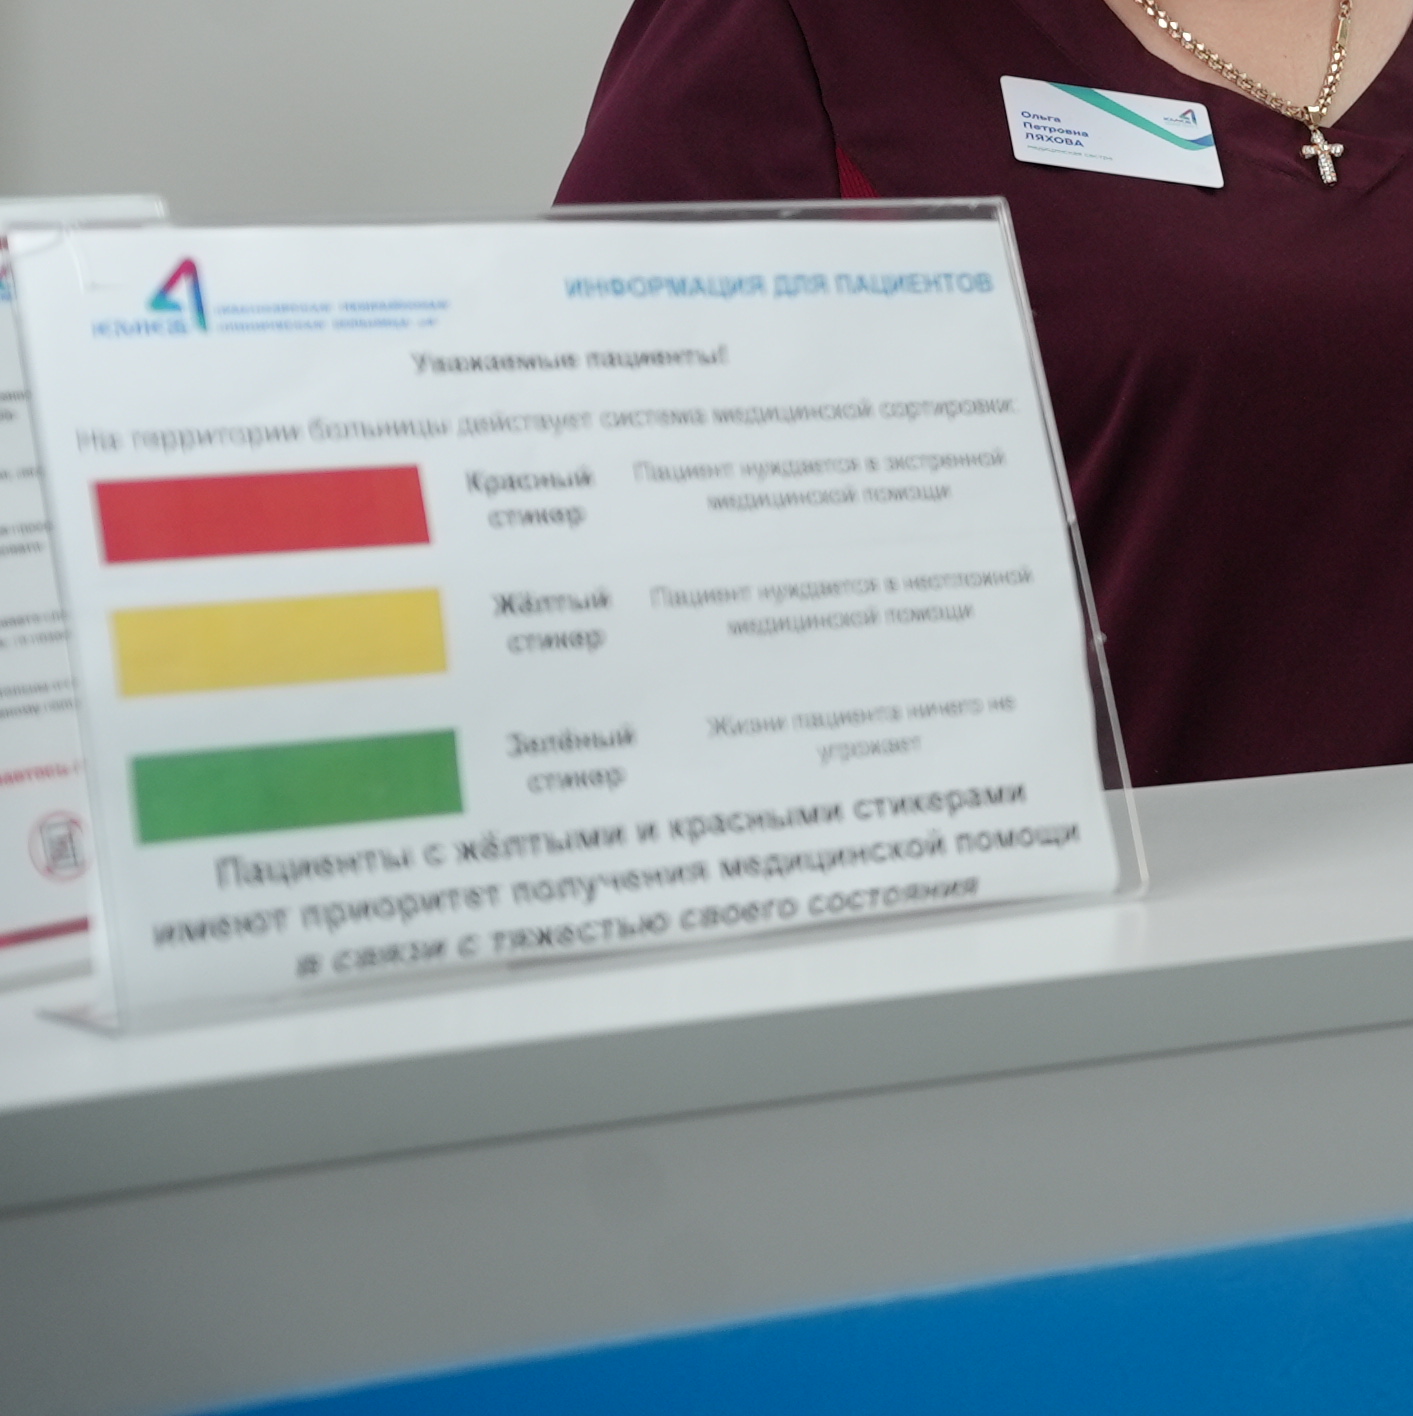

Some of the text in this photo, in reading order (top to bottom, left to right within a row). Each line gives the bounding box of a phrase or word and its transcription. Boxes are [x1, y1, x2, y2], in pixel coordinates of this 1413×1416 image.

[1020, 110, 1062, 123] Ольга
[1023, 121, 1090, 138] Петровна
[1025, 132, 1085, 148] ЛЯХОВА
[565, 271, 994, 300] ИНФОРМАЦИЯ ДЛЯ ПАЦИЕНТОВ
[411, 342, 729, 375] Уважаемые пациенты!
[75, 428, 120, 454] На
[131, 423, 299, 456] территории
[308, 414, 448, 441] больницы
[457, 411, 593, 439] действует
[600, 406, 707, 430] система
[712, 397, 874, 426] медицинской
[465, 464, 596, 497] Красный
[632, 447, 1007, 484] Пациент нуждается в экстренной
[706, 482, 953, 512] медицинской помощи
[487, 505, 588, 530] стикер
[492, 585, 613, 618] Жёлтый
[648, 565, 1034, 610] Пациент нуждается в неотложной
[726, 602, 976, 637] медицинской помощи
[507, 629, 606, 655] стикер
[706, 694, 1018, 738] Жизни пациента ничего не
[507, 723, 637, 759] Зелёный
[816, 734, 923, 766] угрожает
[526, 765, 627, 795] стикер
[213, 779, 1030, 892] Пациенты с жёлтыми и красными стикерами
[153, 820, 1082, 948] имеют приоритет получения медицинской помощи
[331, 936, 449, 972] связи
[456, 932, 482, 958] с
[493, 910, 670, 953] тяжестью
[678, 892, 799, 926] своего
[807, 876, 980, 916] состояния
